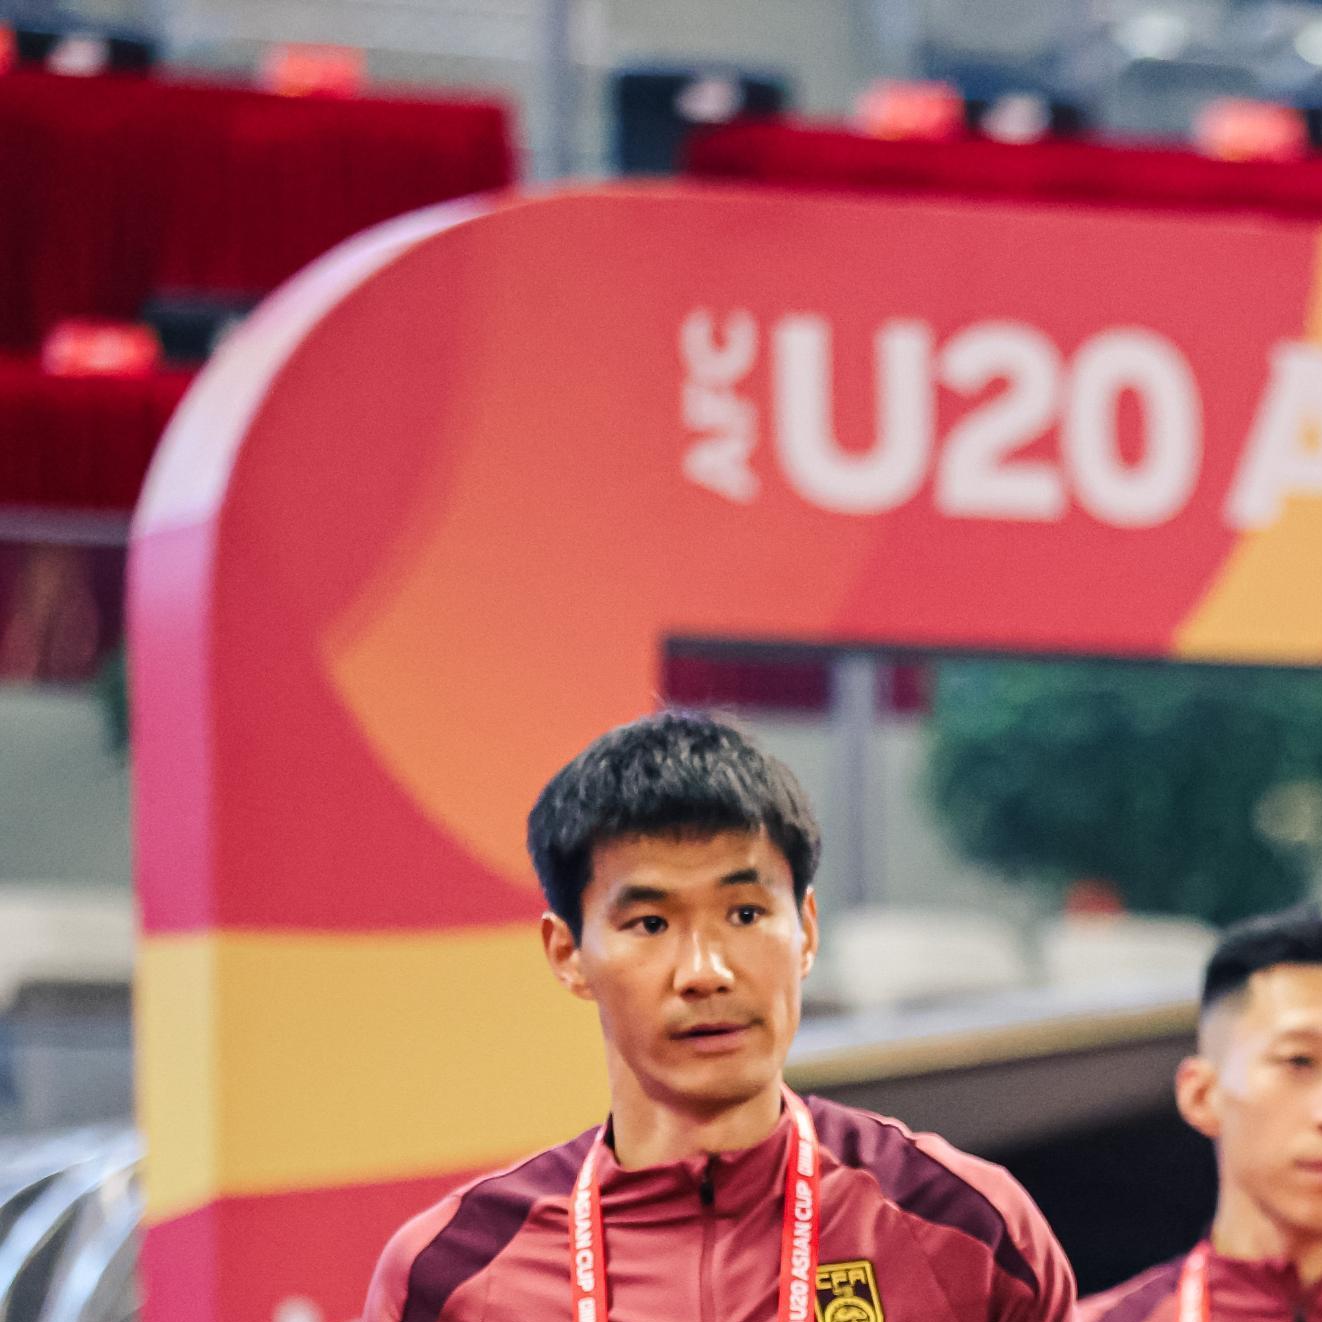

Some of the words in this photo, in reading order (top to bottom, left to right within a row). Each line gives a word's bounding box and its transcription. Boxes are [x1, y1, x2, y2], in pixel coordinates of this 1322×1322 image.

[678, 304, 760, 503] AFC
[772, 314, 1204, 530] U20
[794, 1180, 813, 1224] CUP
[575, 1249, 595, 1293] CUP
[791, 1225, 812, 1282] ASIAN
